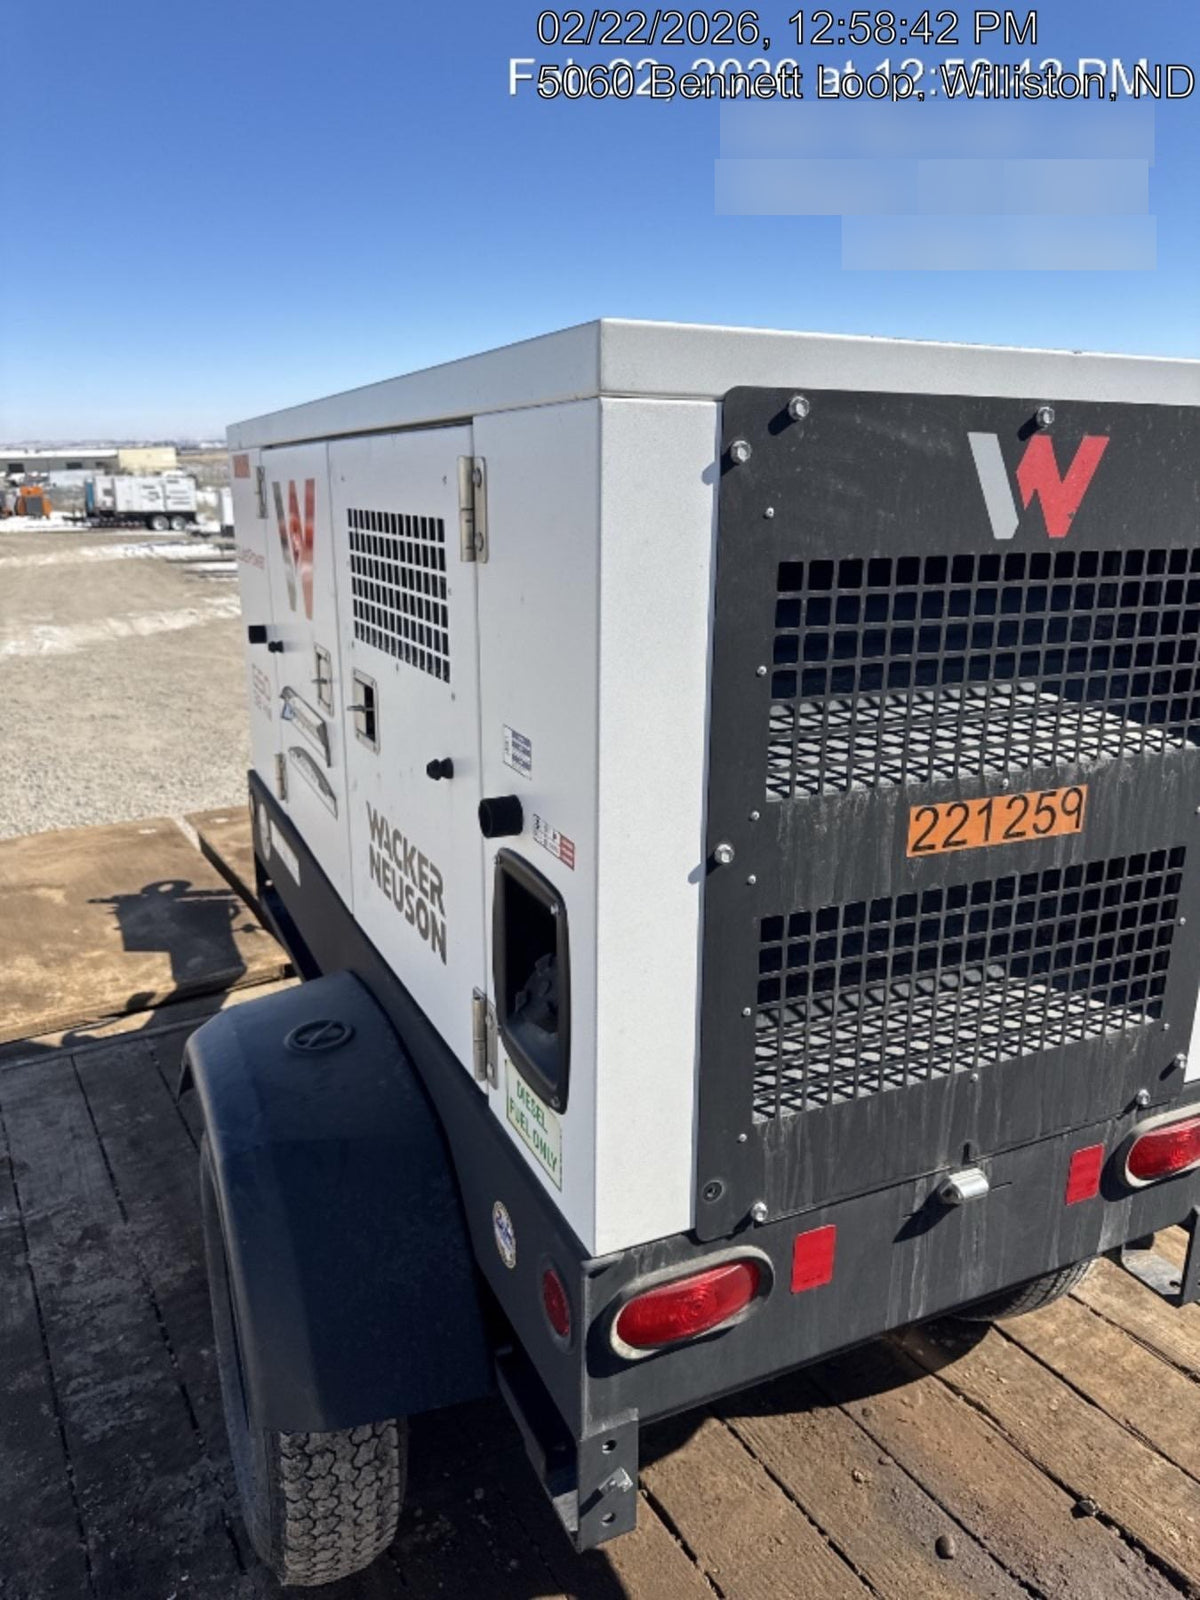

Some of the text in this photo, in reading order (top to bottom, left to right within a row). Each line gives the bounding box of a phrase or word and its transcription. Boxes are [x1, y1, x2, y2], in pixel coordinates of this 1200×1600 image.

[911, 786, 1084, 853] 221259
[366, 800, 447, 919] WACKER
[369, 843, 448, 967] NEUSON
[509, 1097, 558, 1174] FUEL ONLY
[516, 1079, 549, 1134] DIESEL
